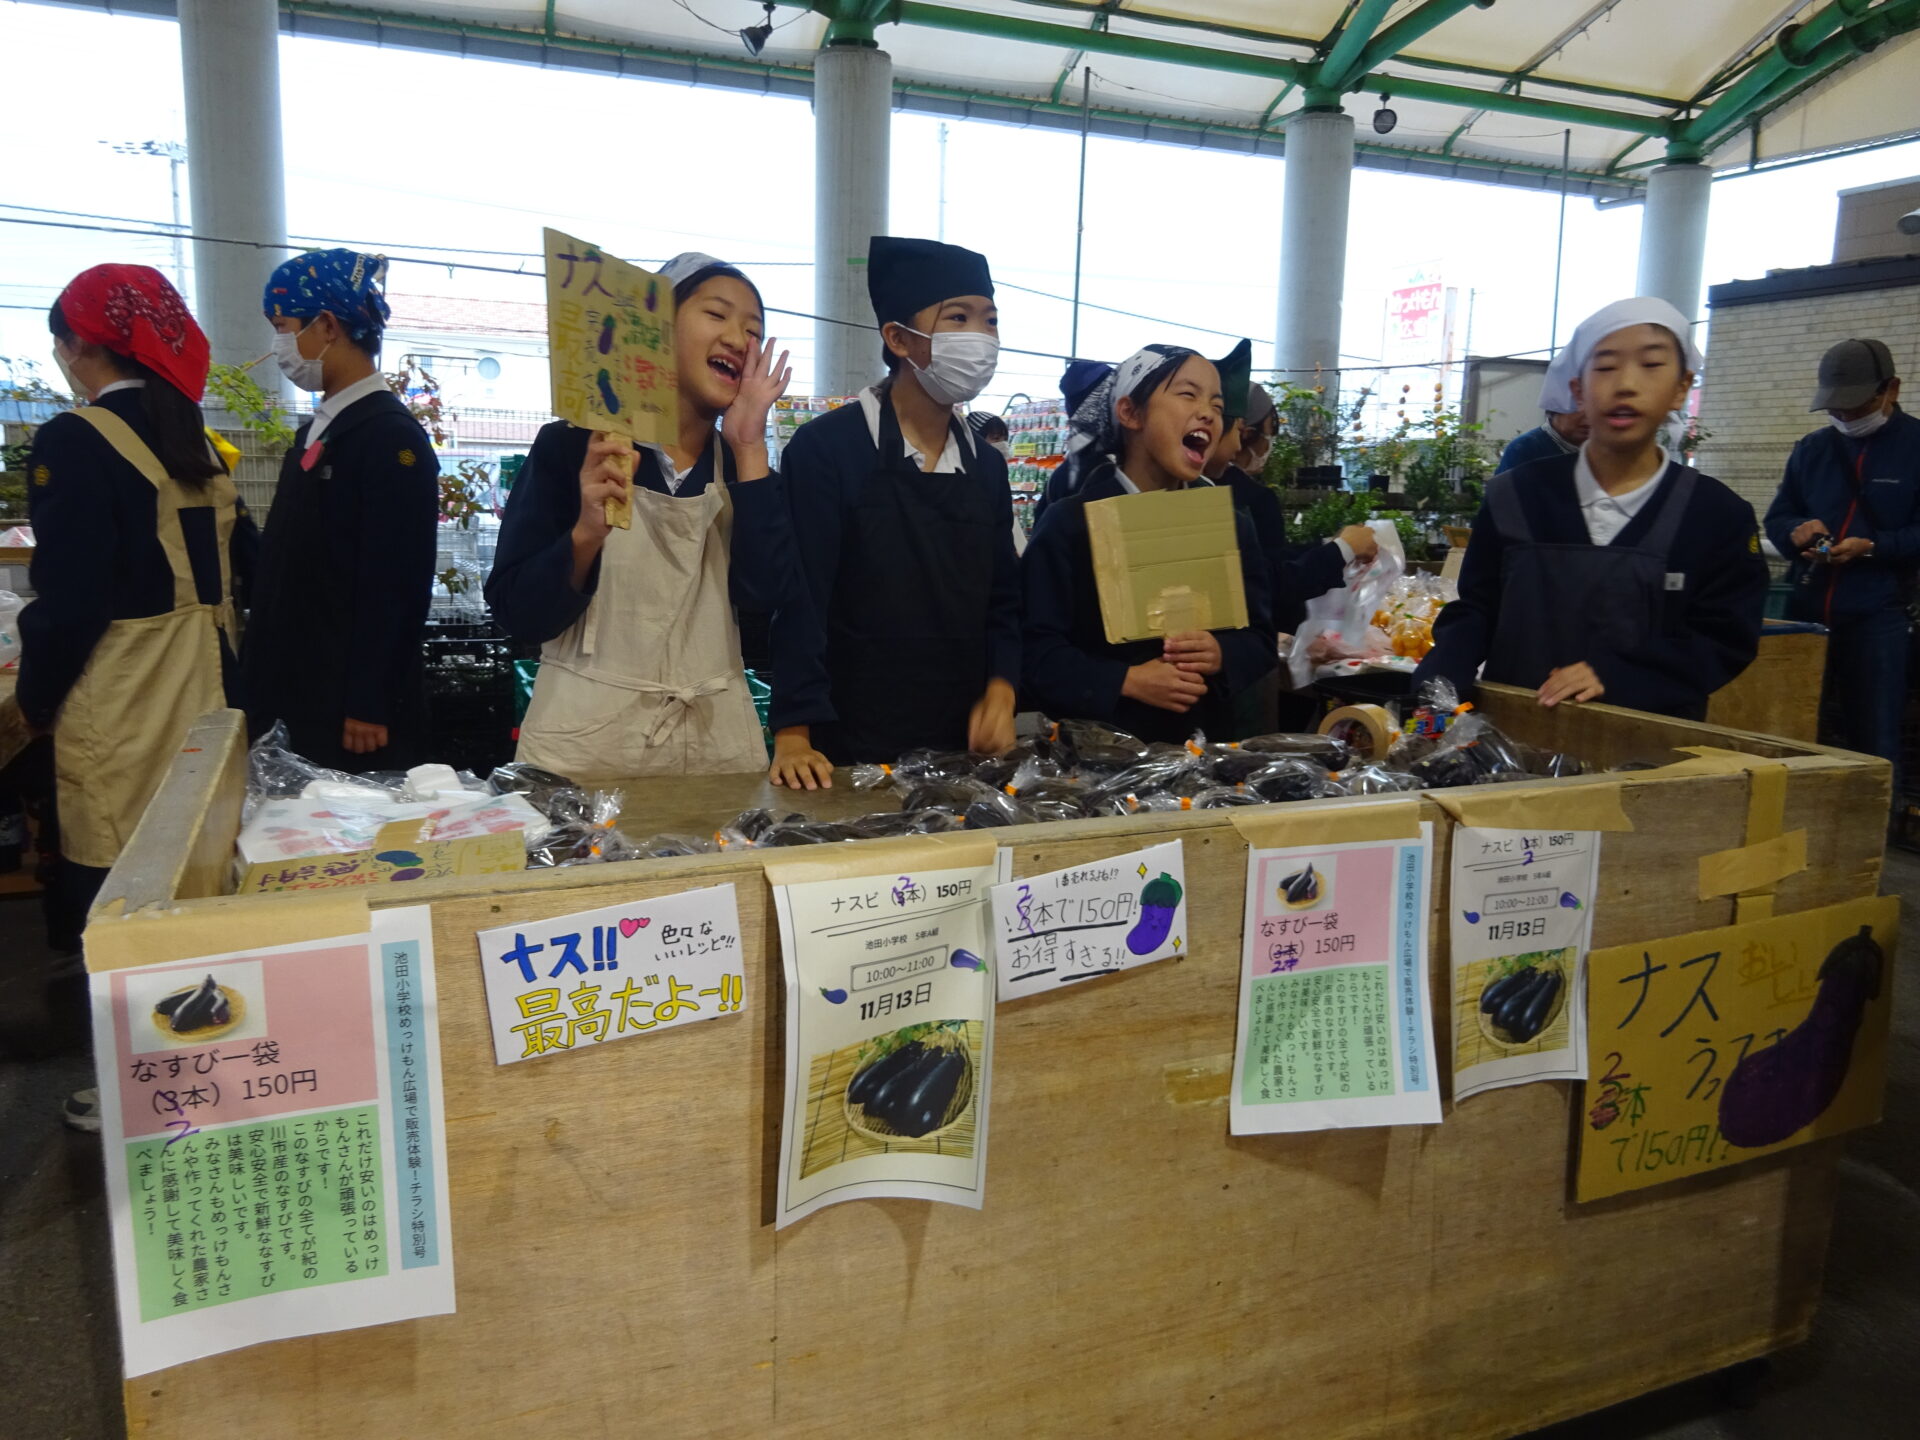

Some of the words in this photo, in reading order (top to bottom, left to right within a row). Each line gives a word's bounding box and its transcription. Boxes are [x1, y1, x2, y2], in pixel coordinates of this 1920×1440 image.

[555, 242, 615, 298] ナス
[1481, 839, 1513, 854] ナスビ
[1548, 832, 1575, 847] 150円
[831, 890, 879, 914] ナスビ
[936, 880, 972, 899] 150円
[1260, 912, 1339, 938] なすび一袋
[1315, 934, 1356, 956] 150円
[1488, 917, 1546, 941] 11月13日
[859, 982, 932, 1021] 11月13日
[1616, 951, 1722, 1039] ナス
[130, 1040, 281, 1083] なすび一袋
[241, 1068, 318, 1101] 150円
[227, 1133, 252, 1240] は美味しいです。
[248, 1128, 276, 1288] 安心安全で新鮮ななすび
[270, 1125, 297, 1261] 川市産のなすびです。
[293, 1122, 319, 1280] このなすびの全てが紀の
[356, 1112, 380, 1271] これだけ安いのはめっけ
[204, 1137, 233, 1297] みなさんもめっけもんさ
